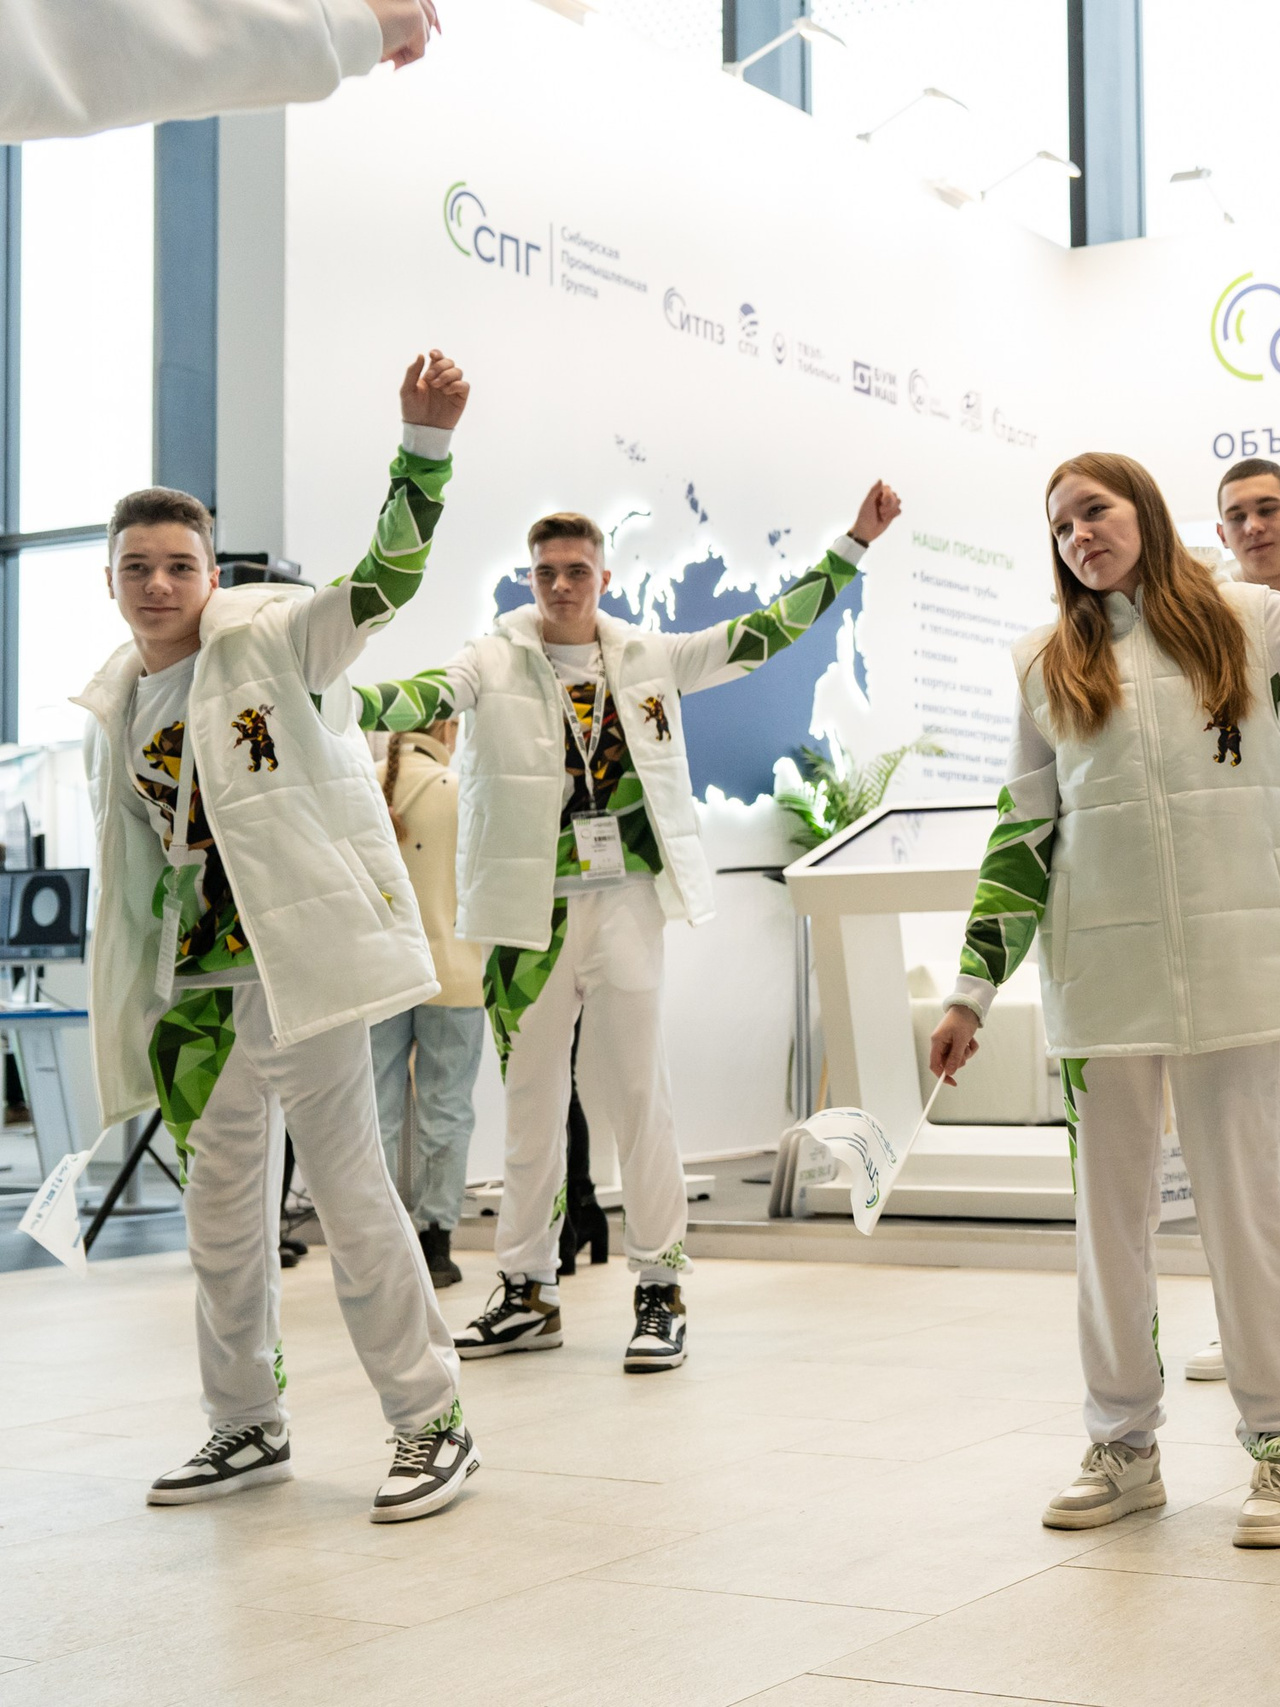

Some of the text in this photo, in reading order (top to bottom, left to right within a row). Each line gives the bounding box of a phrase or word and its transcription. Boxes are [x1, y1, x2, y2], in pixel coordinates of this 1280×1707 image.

[473, 225, 541, 277] СПГ
[560, 226, 621, 260] Сибирская
[560, 249, 649, 294] Промышленная
[560, 273, 599, 300] Группа
[912, 530, 1015, 571] НАШИ ПРОДУКТЫ
